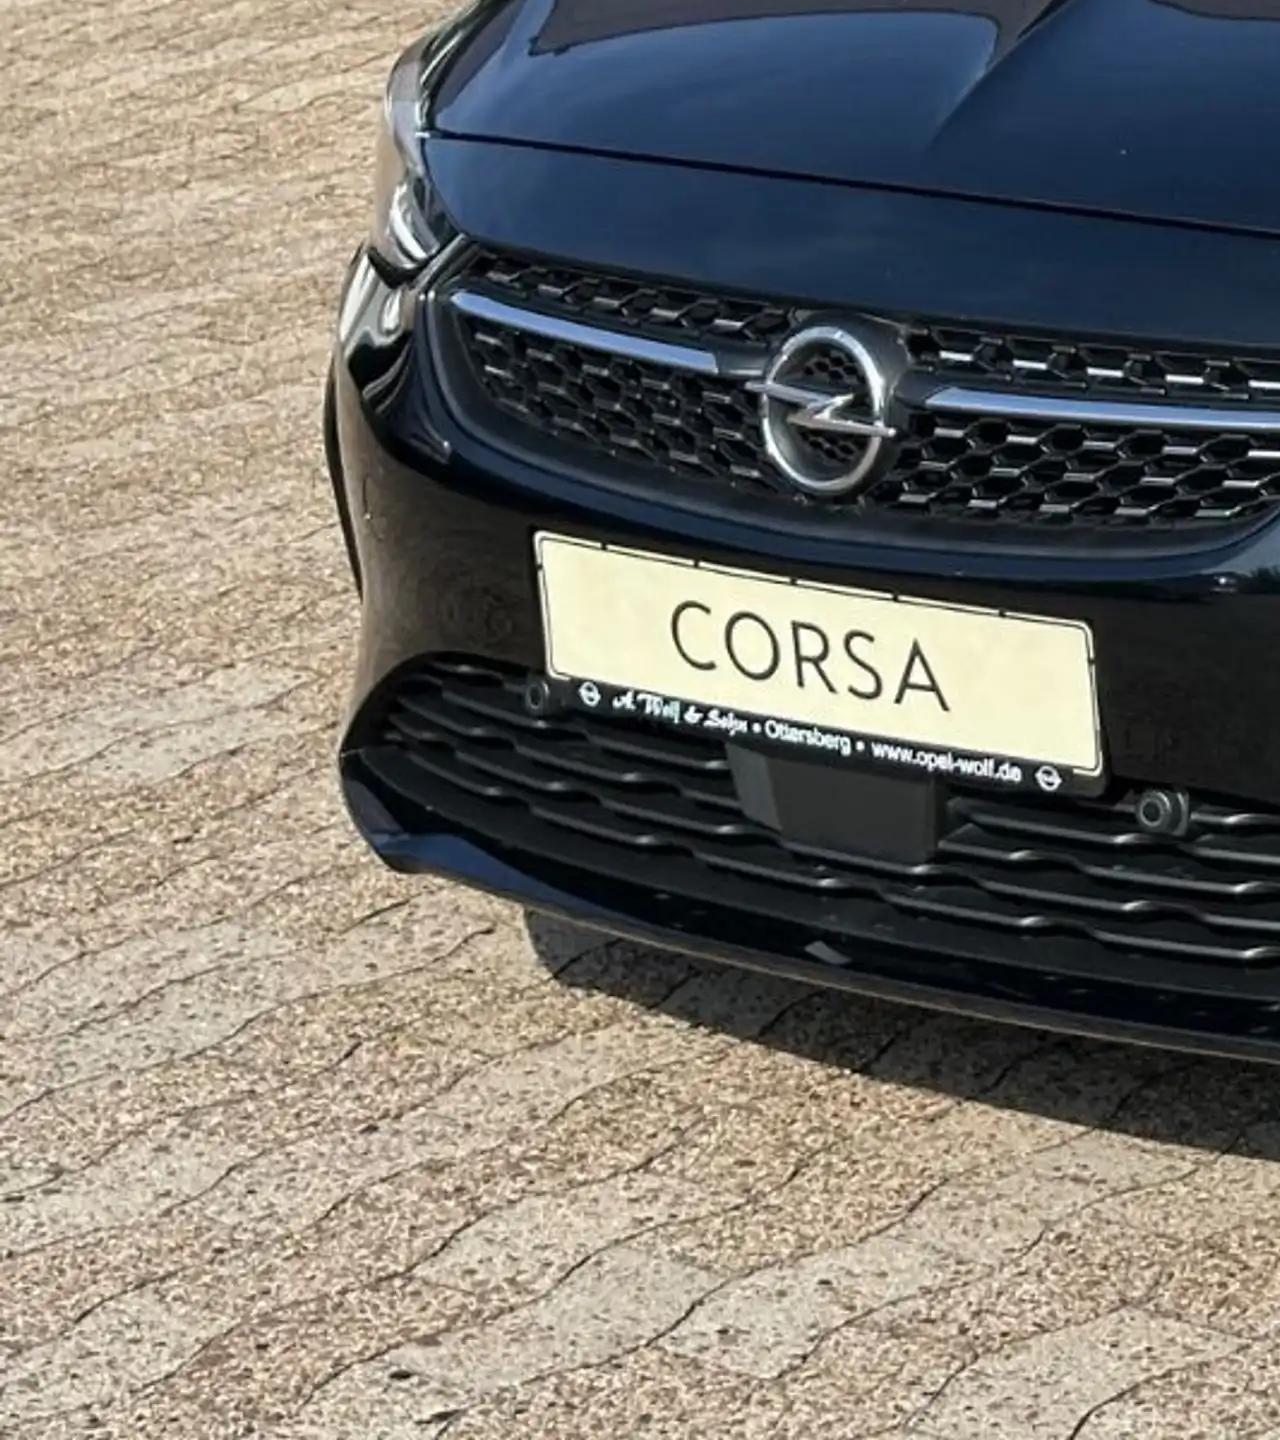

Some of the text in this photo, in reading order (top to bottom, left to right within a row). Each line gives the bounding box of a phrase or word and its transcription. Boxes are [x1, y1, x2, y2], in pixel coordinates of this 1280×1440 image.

[671, 601, 950, 712] CORSA
[683, 705, 704, 724] &
[765, 720, 851, 756] Ottersberg
[871, 740, 1022, 783] www.opel-wolf.de
